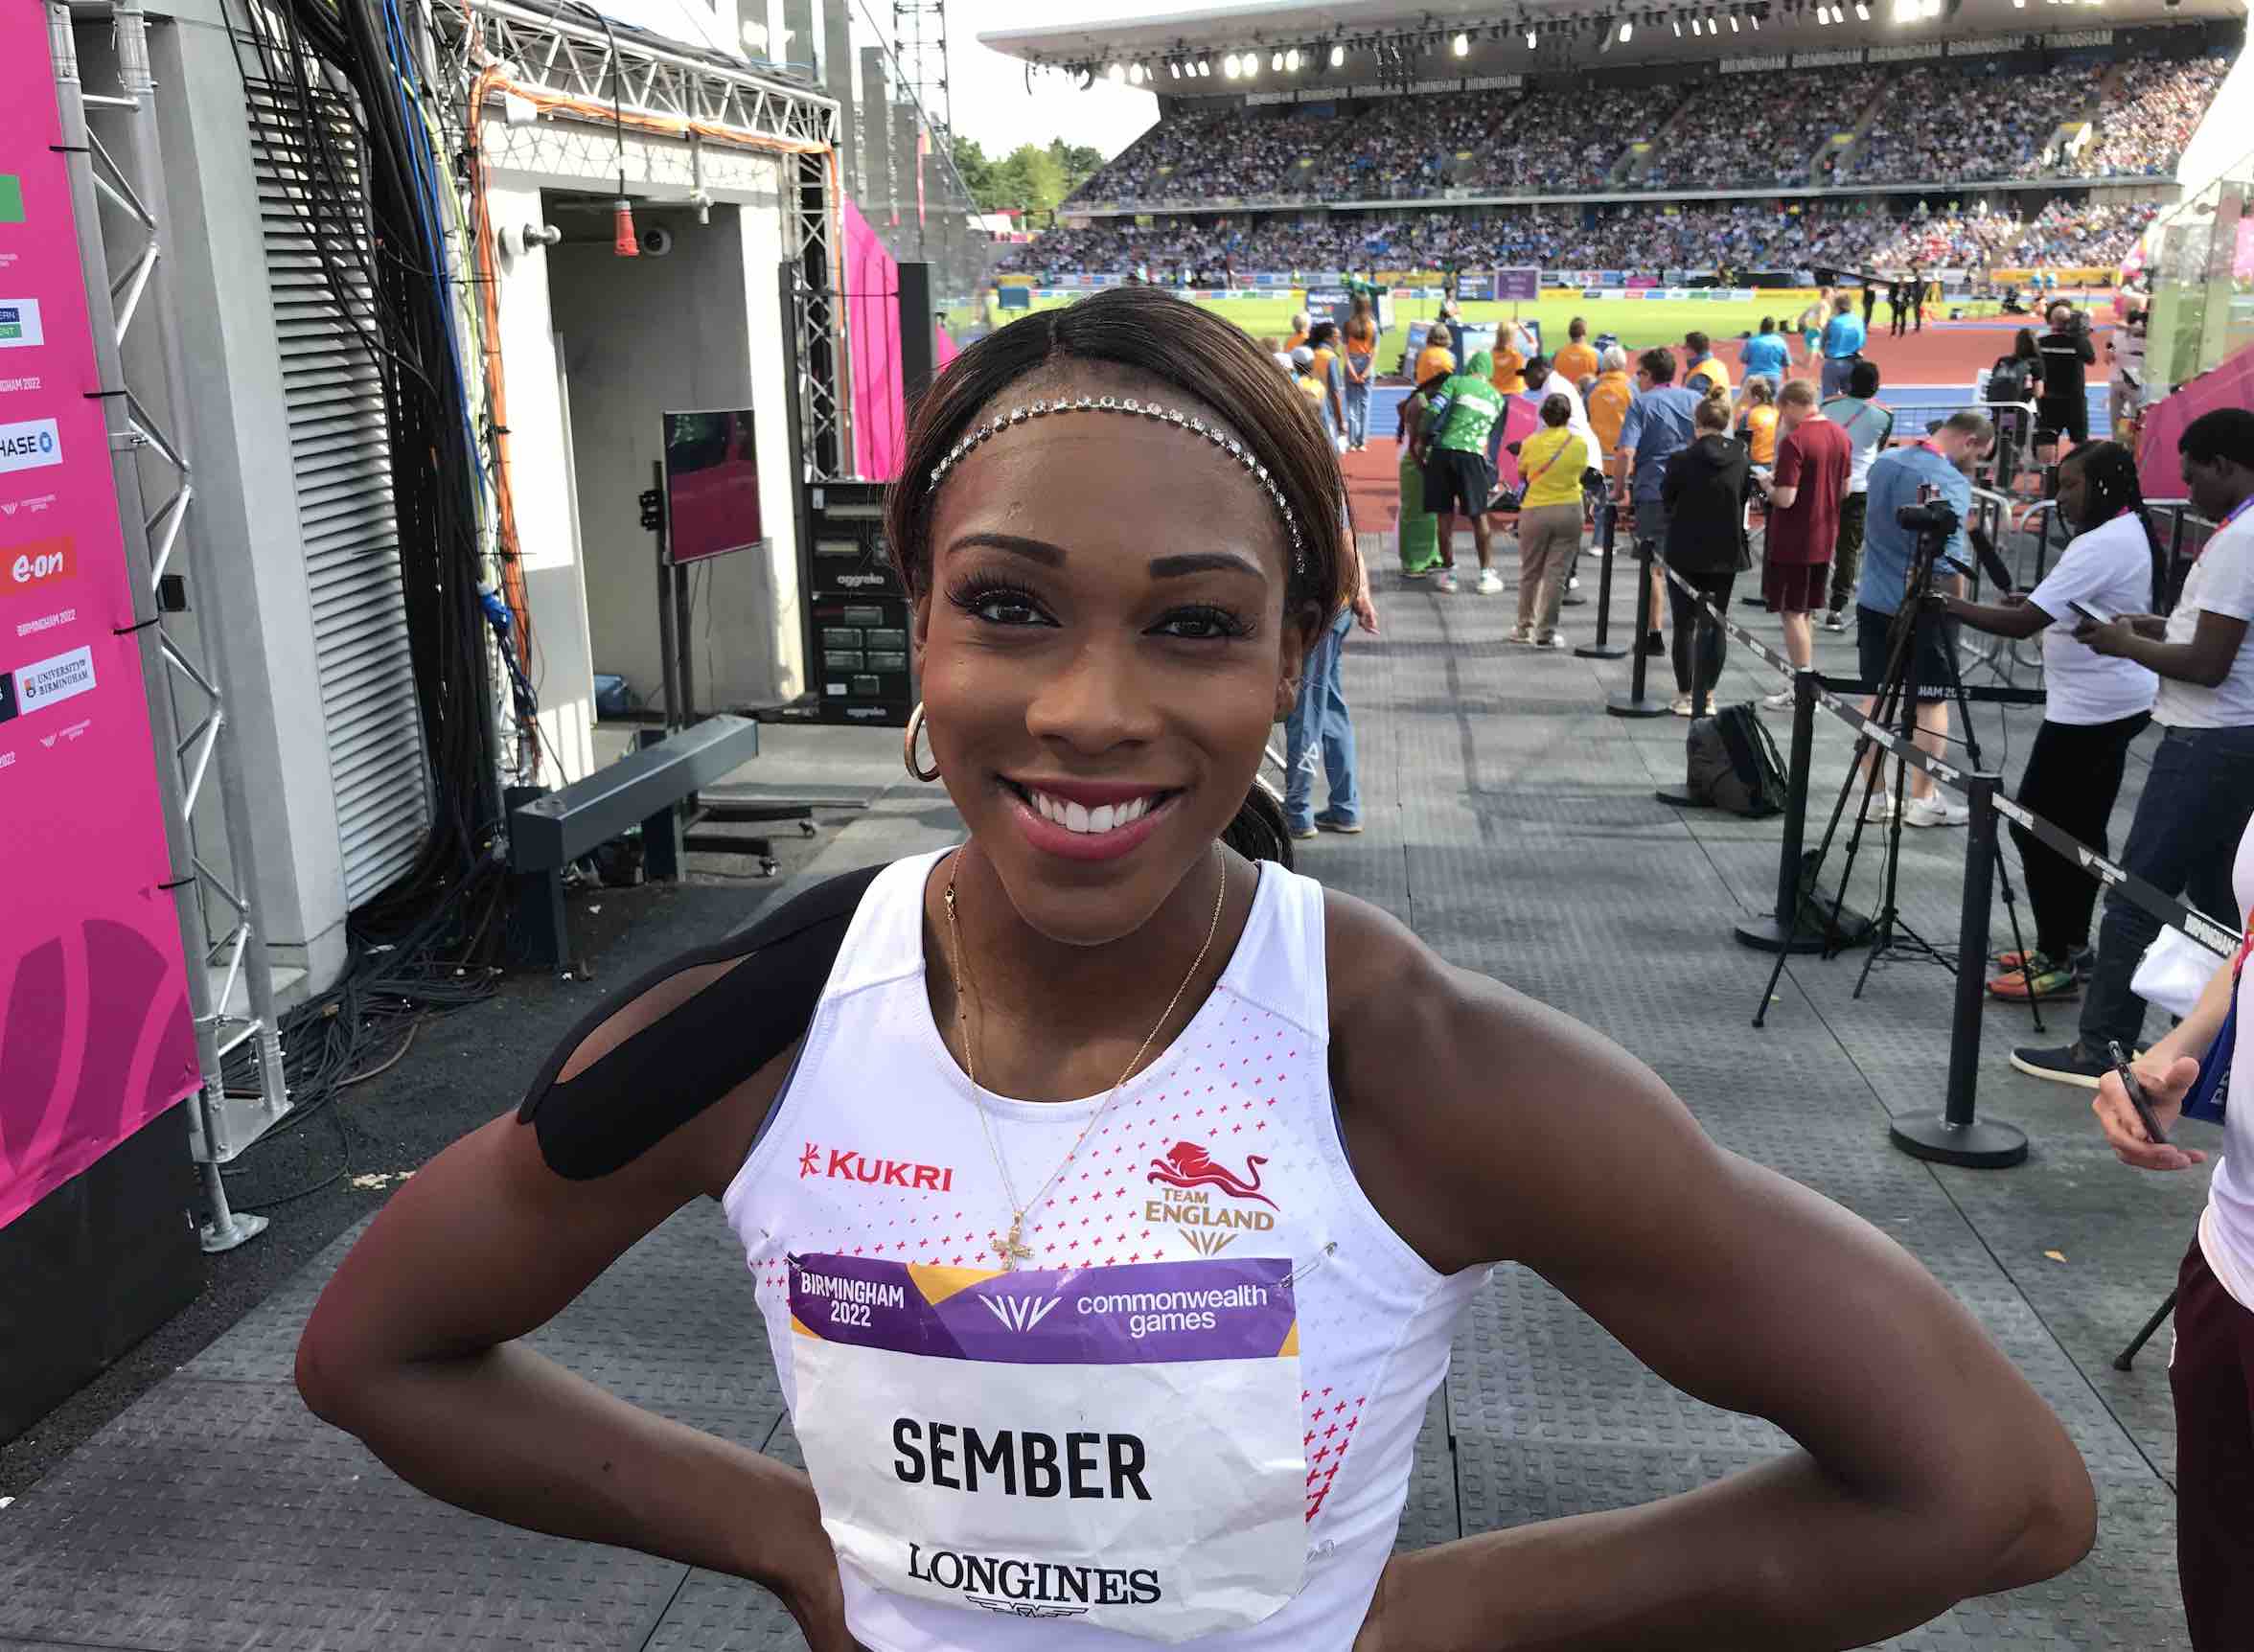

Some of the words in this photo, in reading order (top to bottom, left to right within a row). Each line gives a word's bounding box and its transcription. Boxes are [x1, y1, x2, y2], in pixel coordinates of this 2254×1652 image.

[837, 574, 885, 587] aggreko
[37, 662, 80, 683] UNIVERSITY
[39, 671, 88, 696] BIRMINGHAM
[826, 1149, 953, 1192] KUKRI
[1162, 1187, 1208, 1205] TEAM
[1144, 1200, 1275, 1231] ENGLAND
[800, 1271, 905, 1310] BIRMINGHAM
[1076, 1284, 1269, 1315] commonwealth
[830, 1299, 872, 1327] 2022
[1129, 1311, 1217, 1339] games
[892, 1417, 1153, 1502] SEMBER
[908, 1542, 1162, 1606] LONGINES
